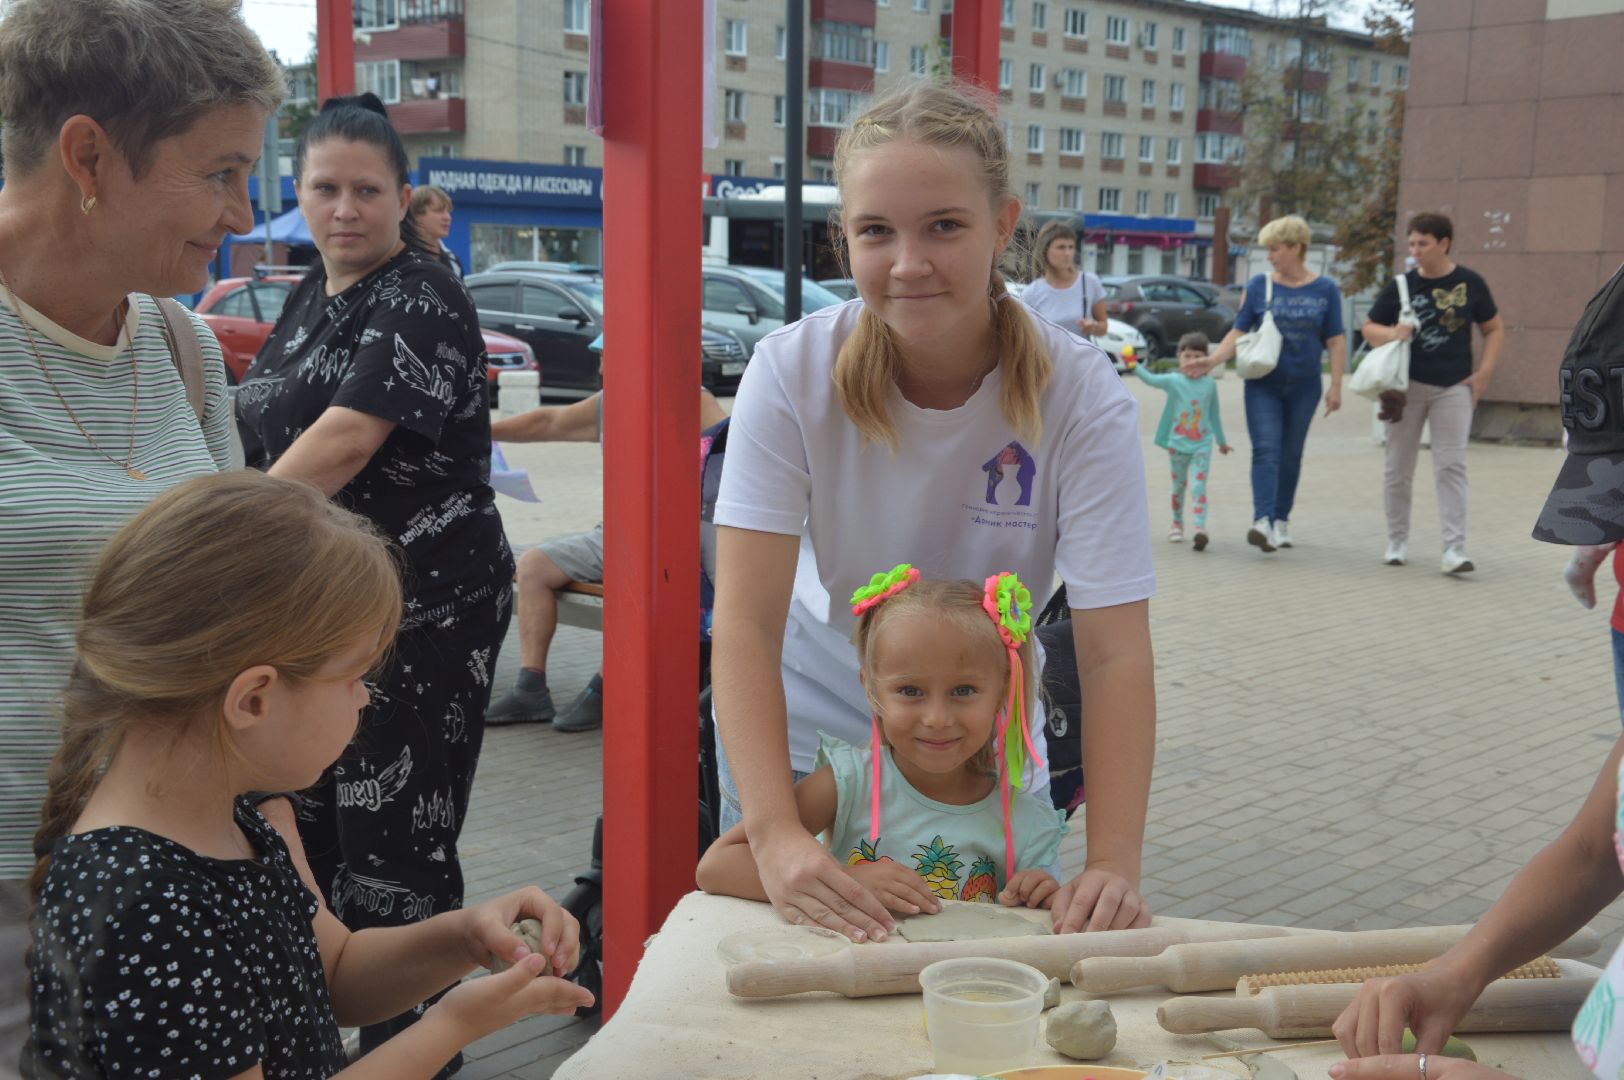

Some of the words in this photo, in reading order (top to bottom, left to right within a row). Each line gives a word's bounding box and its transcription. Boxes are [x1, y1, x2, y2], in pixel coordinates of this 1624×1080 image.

[429, 170, 476, 192] МОДНАЯ
[477, 172, 522, 194] ОДЕЖДА
[523, 175, 532, 192] И
[533, 176, 592, 196] АКСЕССУАРЫ
[1005, 521, 1038, 531] мастер
[337, 778, 381, 812] ney
